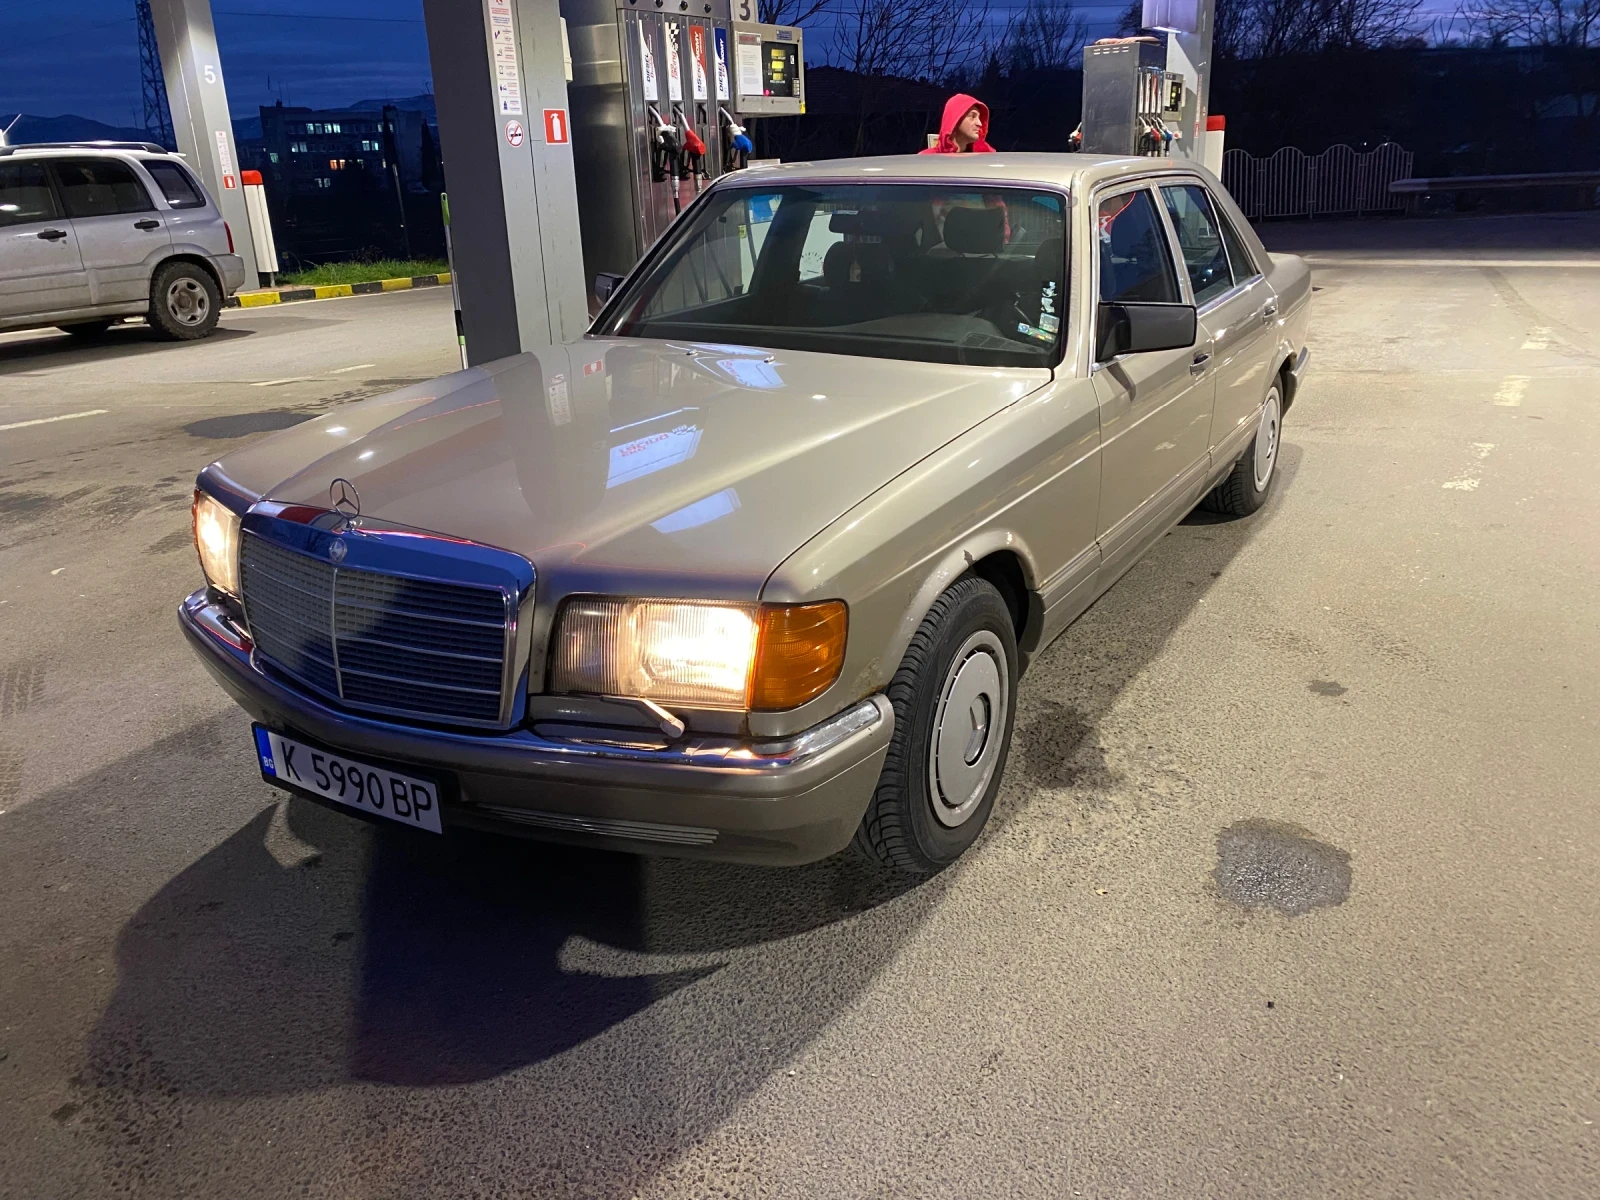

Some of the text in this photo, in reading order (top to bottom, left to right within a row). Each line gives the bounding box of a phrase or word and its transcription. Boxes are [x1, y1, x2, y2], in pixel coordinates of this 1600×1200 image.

[739, 0, 751, 21] 3
[204, 64, 216, 85] 5
[263, 756, 275, 769] BG
[280, 741, 432, 822] K 5990 BP
